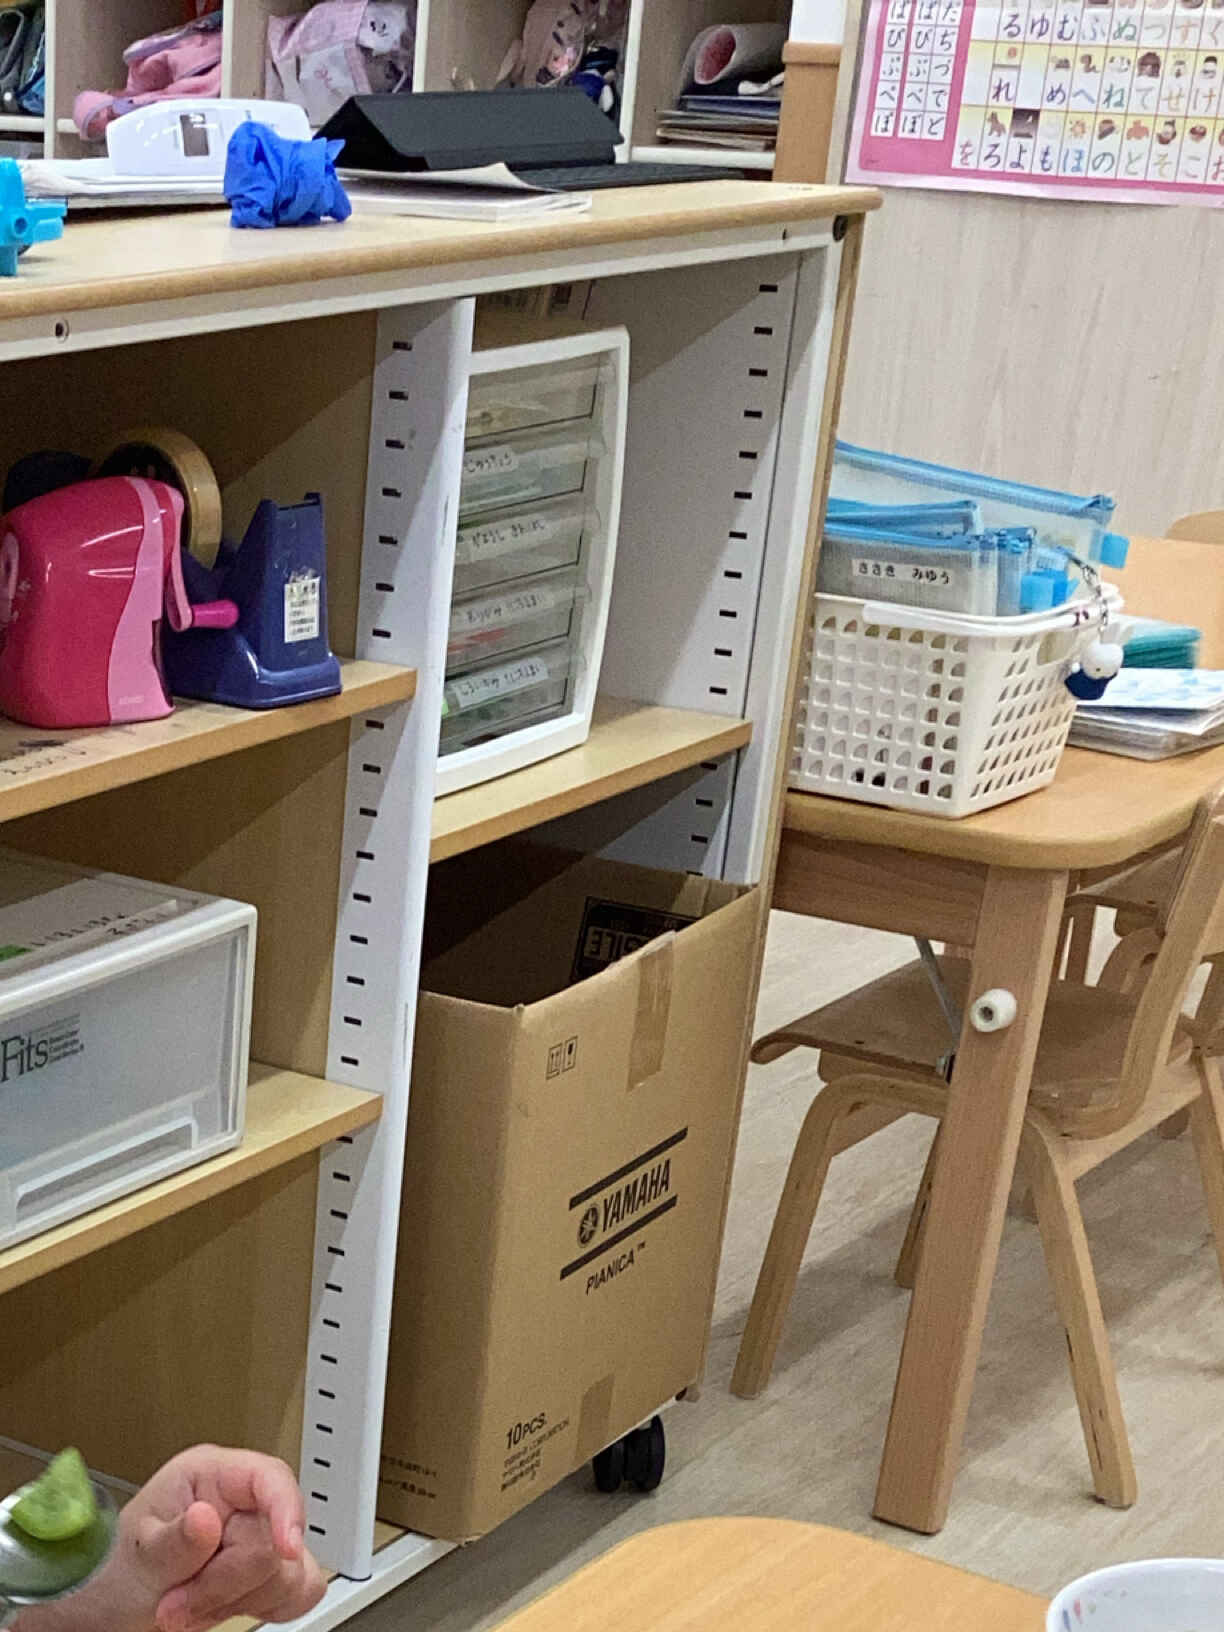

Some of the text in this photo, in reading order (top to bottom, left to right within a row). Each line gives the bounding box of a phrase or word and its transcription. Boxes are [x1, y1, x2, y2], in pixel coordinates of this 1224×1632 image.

[0, 1035, 49, 1083] Fits
[603, 1158, 671, 1232] YAMAHA
[585, 1248, 636, 1296] PIANICA
